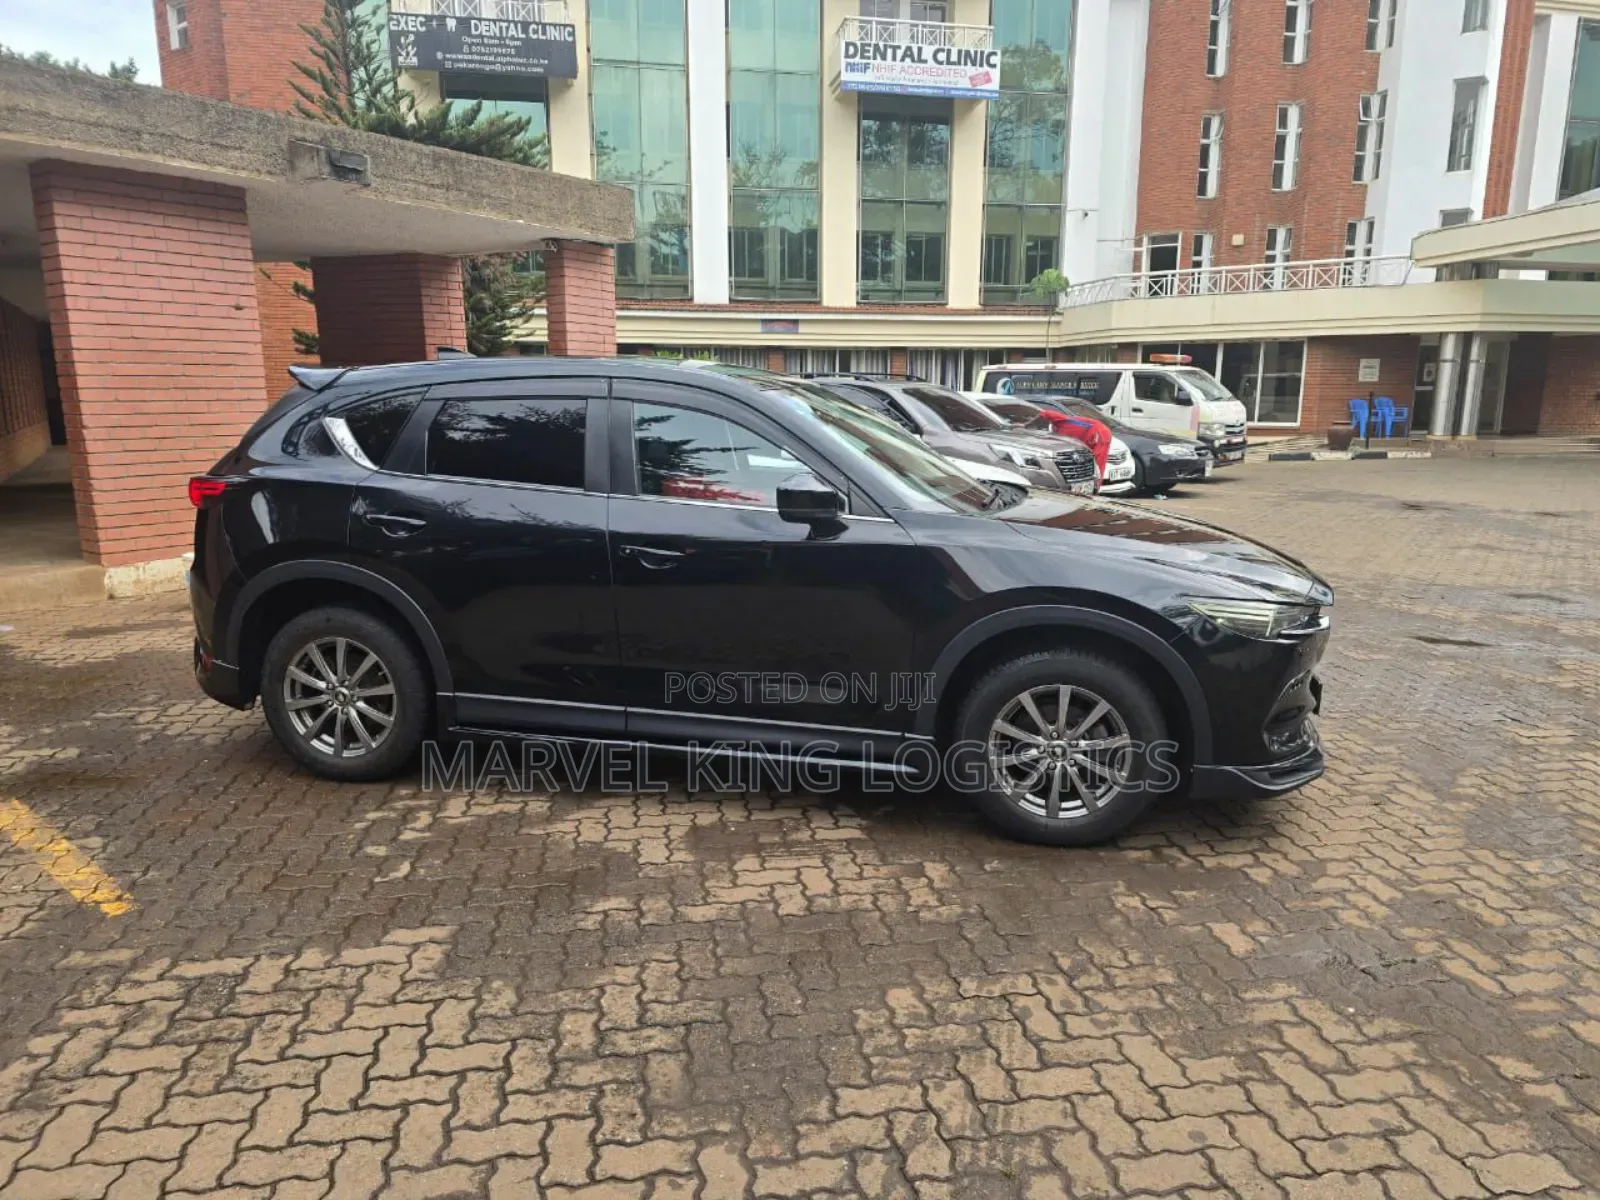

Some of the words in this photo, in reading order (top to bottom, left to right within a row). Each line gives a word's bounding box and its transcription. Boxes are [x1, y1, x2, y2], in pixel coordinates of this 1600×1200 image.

[389, 14, 426, 32] EXEC
[470, 19, 526, 39] DENTAL
[528, 24, 574, 41] CLINIC
[843, 41, 928, 64] DENTAL
[931, 48, 998, 69] CLINIC
[872, 63, 896, 74] NHIF
[900, 65, 967, 78] ACCREDITED
